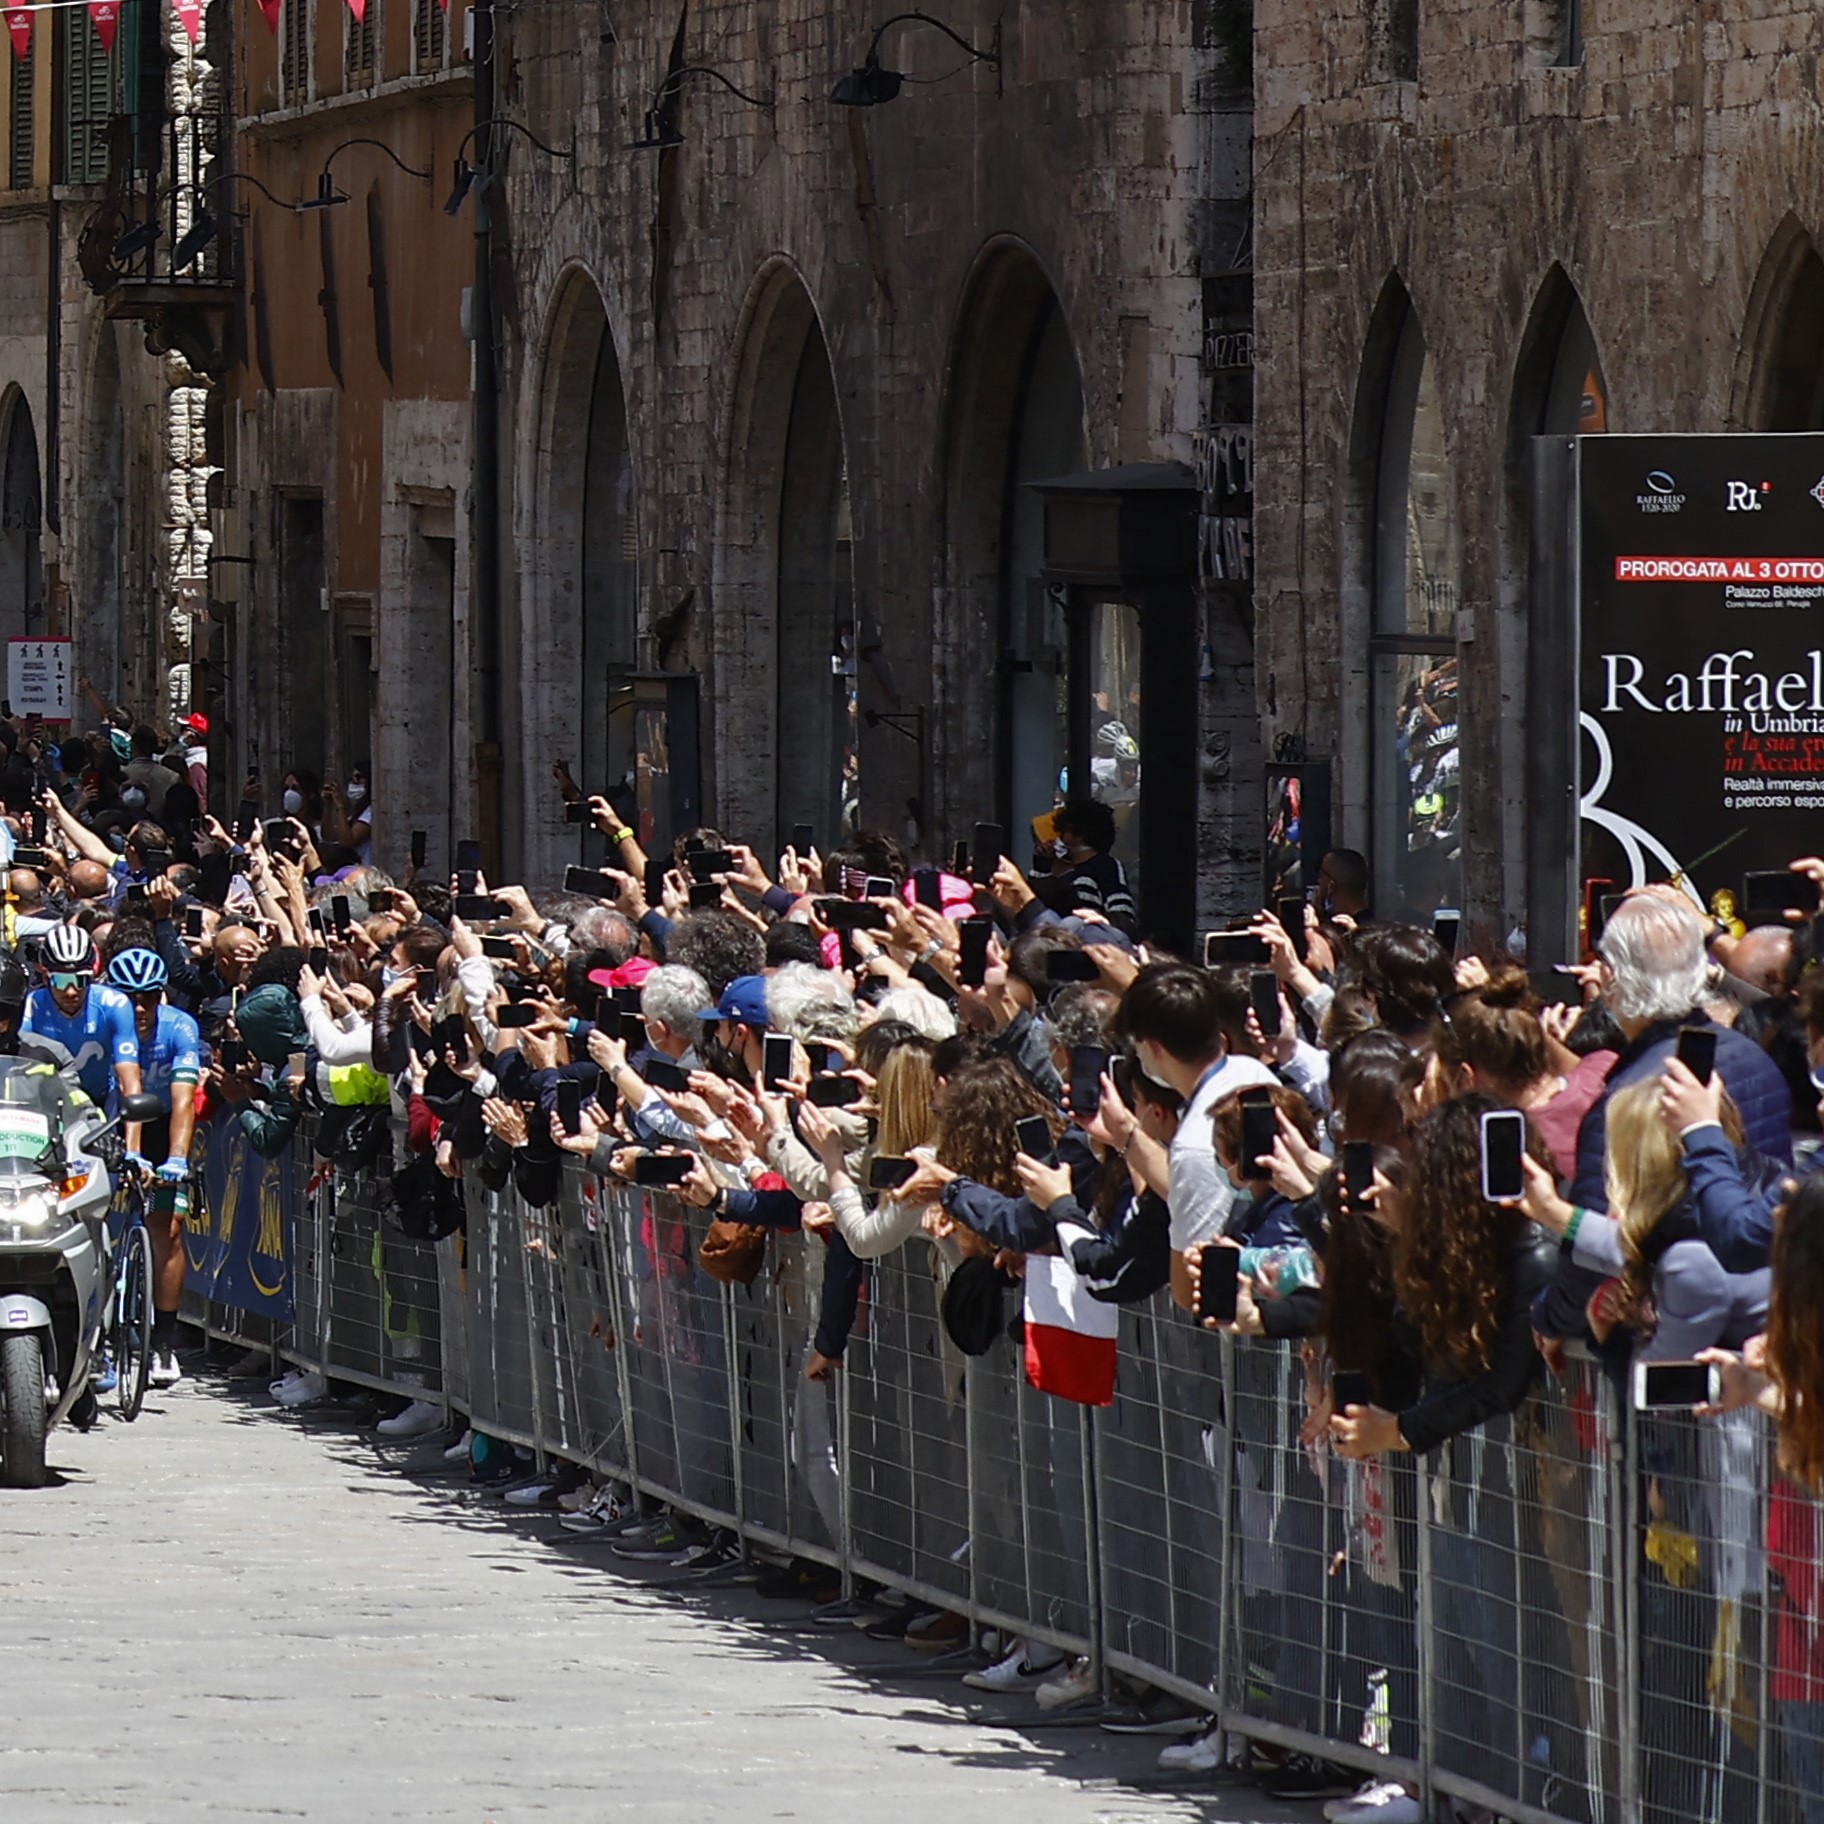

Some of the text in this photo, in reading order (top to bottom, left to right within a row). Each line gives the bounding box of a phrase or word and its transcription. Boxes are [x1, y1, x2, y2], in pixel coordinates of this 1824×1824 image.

[1619, 561, 1729, 577] PROROGATA
[1732, 562, 1756, 578] AL
[1759, 562, 1771, 578] 3
[1726, 585, 1770, 598] Palazzo
[1601, 650, 1824, 713] Raffael
[1725, 714, 1742, 733] in
[1724, 778, 1764, 791] Realtà
[1725, 797, 1733, 808] e
[1736, 796, 1791, 810] percorso
